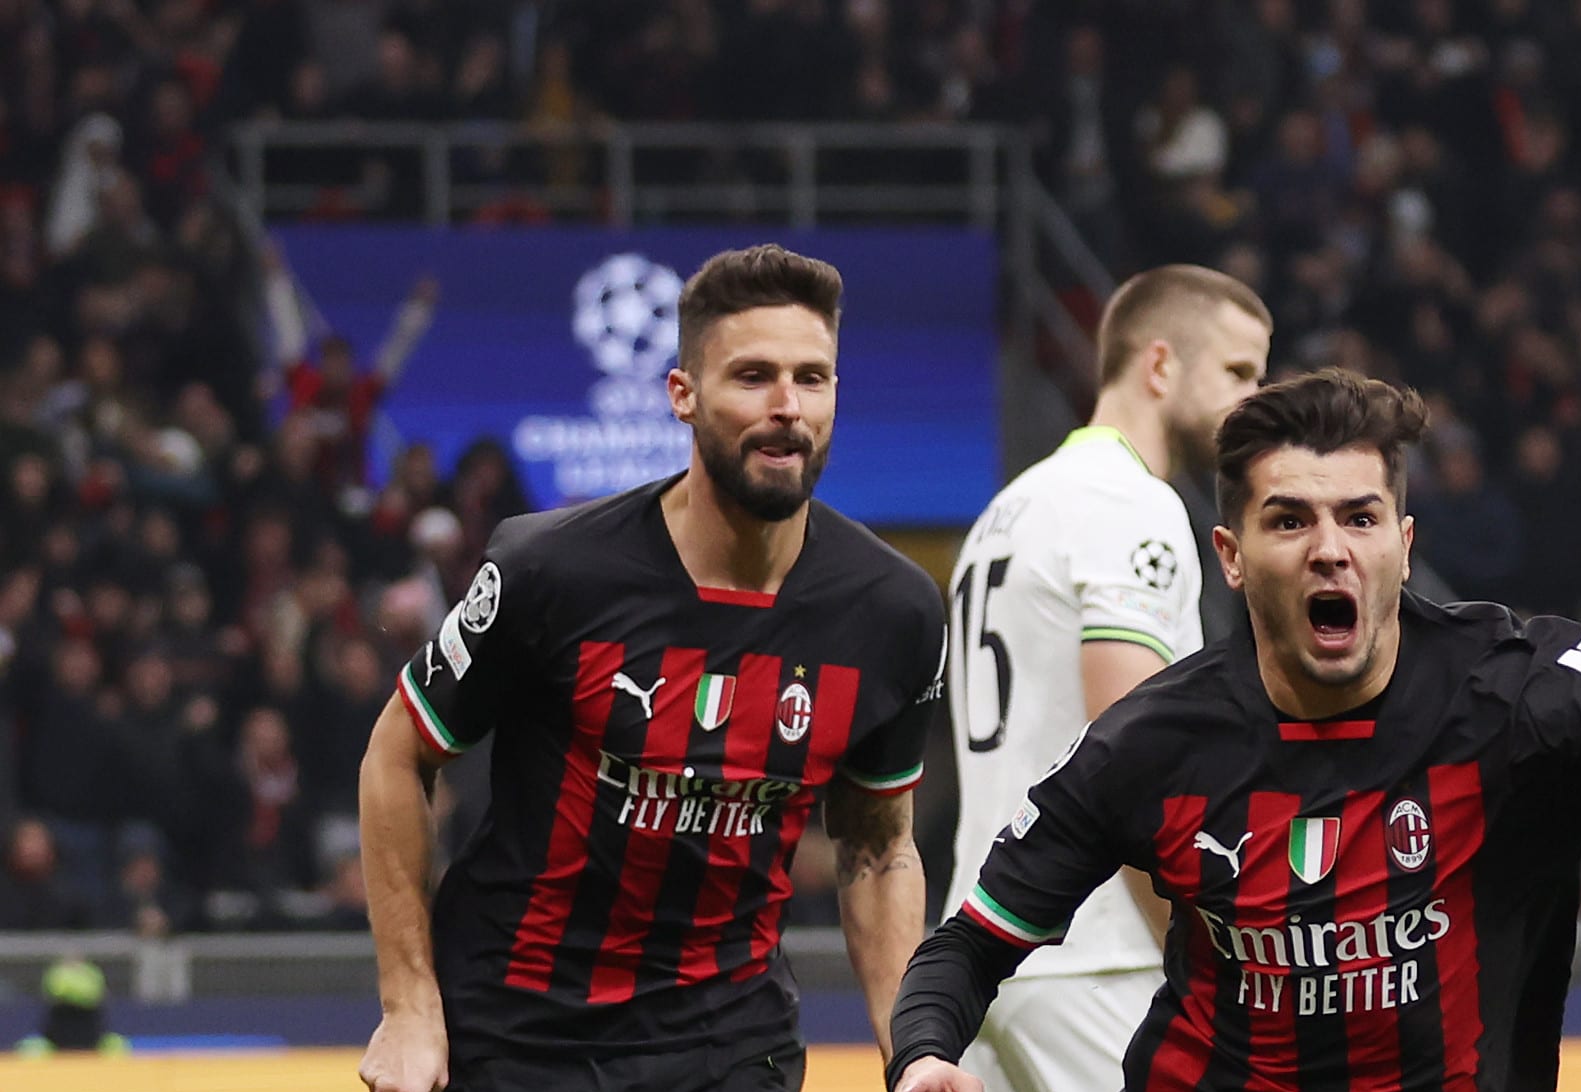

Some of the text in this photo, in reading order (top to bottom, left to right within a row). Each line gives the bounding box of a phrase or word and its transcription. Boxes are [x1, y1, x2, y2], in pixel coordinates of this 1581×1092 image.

[954, 553, 1014, 753] 15
[617, 796, 772, 838] FLY BETTER
[1394, 802, 1421, 817] ACM
[1401, 853, 1423, 864] 1899
[1195, 898, 1451, 968] Emirates
[1237, 959, 1420, 1016] FLY BETTER
